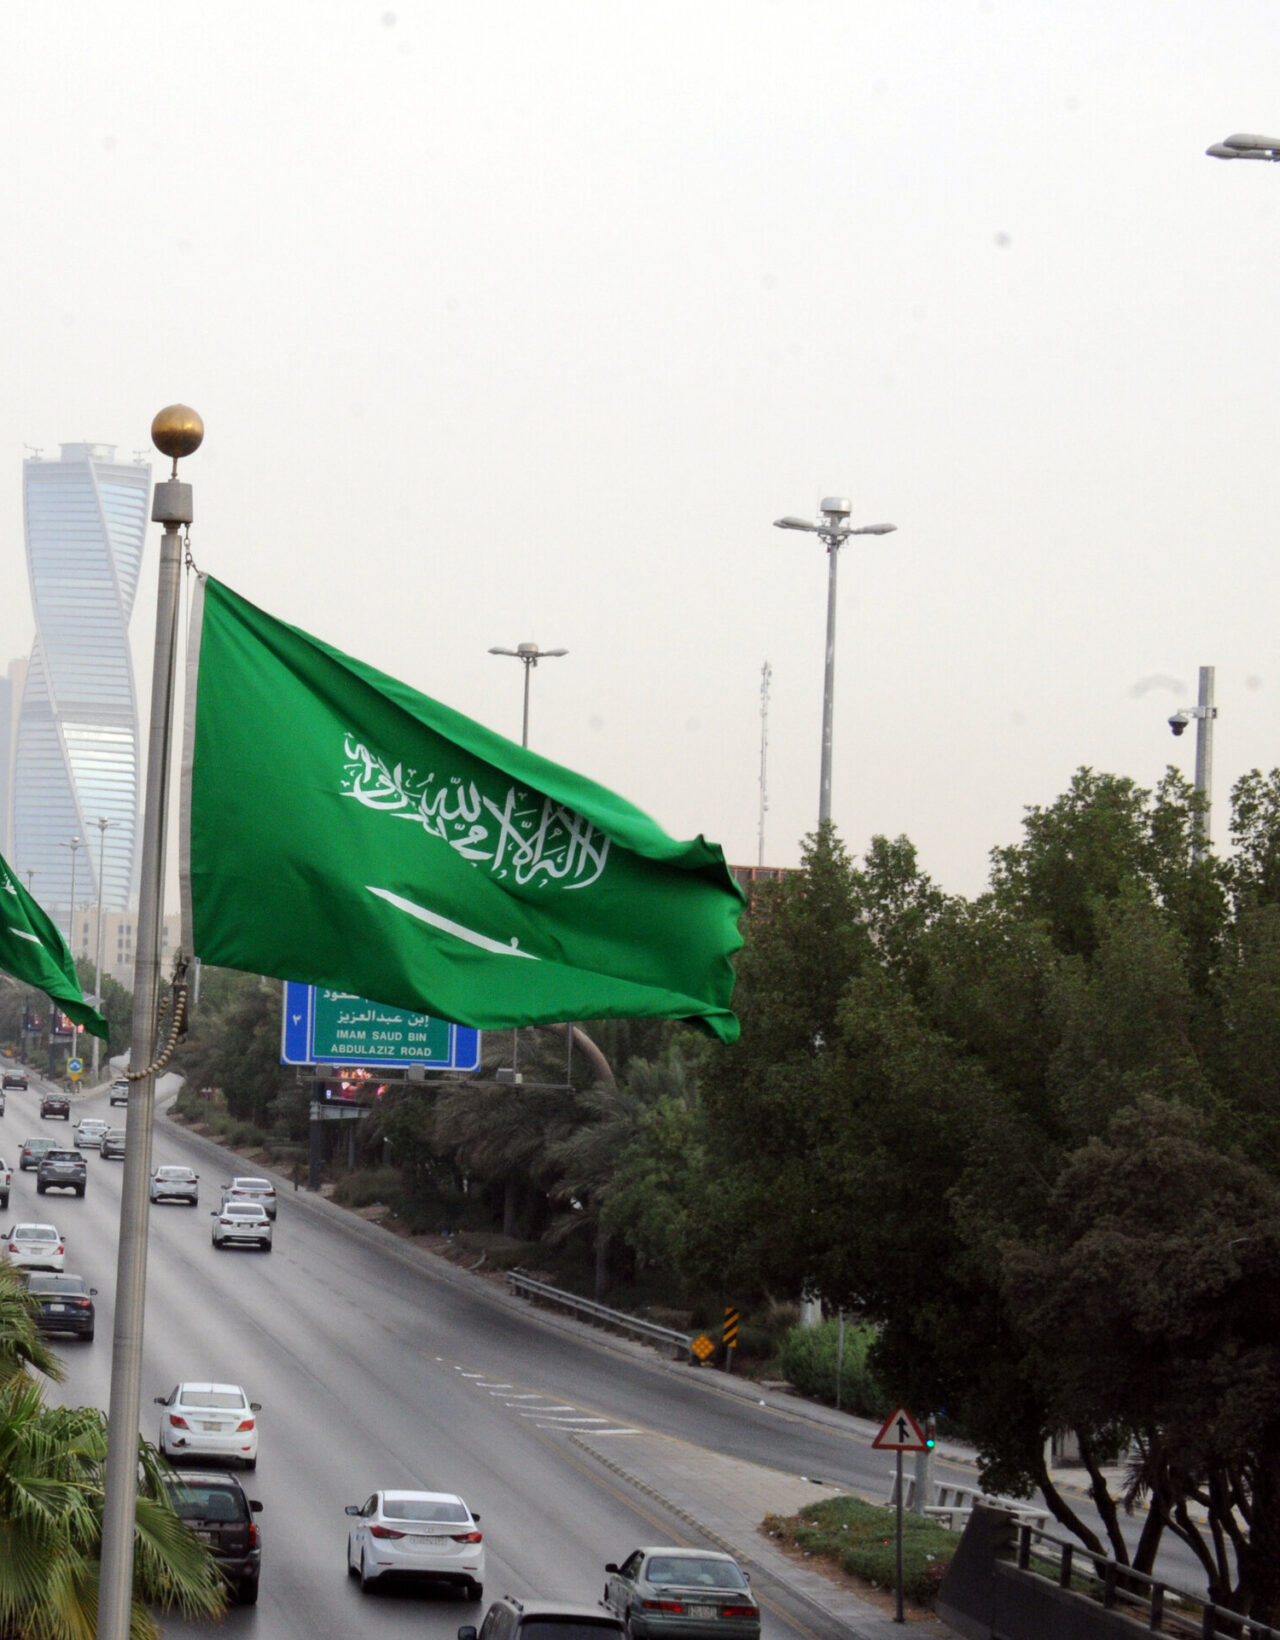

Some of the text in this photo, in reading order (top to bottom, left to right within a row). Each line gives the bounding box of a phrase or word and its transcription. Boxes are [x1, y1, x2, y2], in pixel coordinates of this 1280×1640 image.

[336, 1029, 427, 1042] IMAM SAUD BIN
[331, 1044, 432, 1057] ABDULAZIZ ROAD
